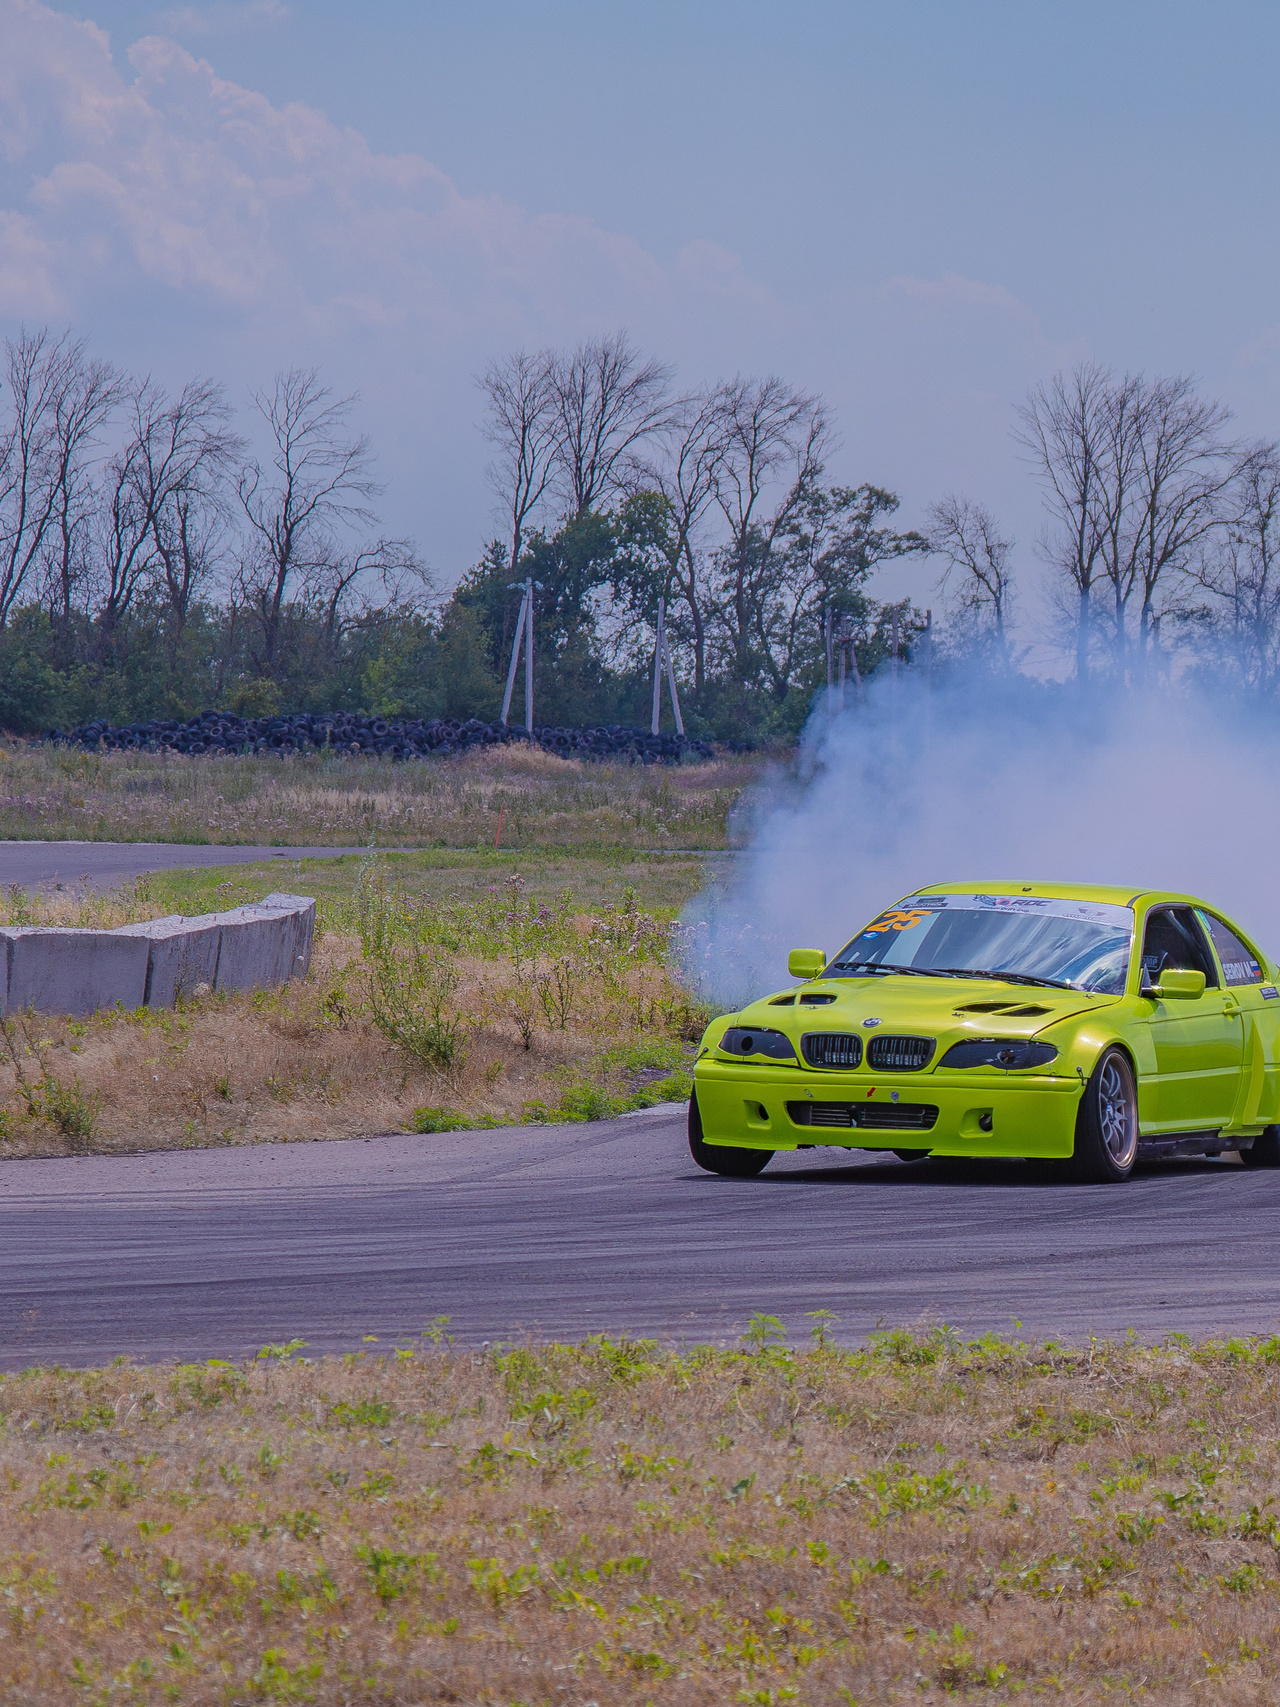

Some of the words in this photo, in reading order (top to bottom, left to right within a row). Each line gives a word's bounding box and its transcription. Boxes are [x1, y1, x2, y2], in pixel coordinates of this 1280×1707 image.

[1010, 899, 1052, 907] RDC
[865, 910, 933, 932] 25
[1222, 962, 1246, 980] SEROV
